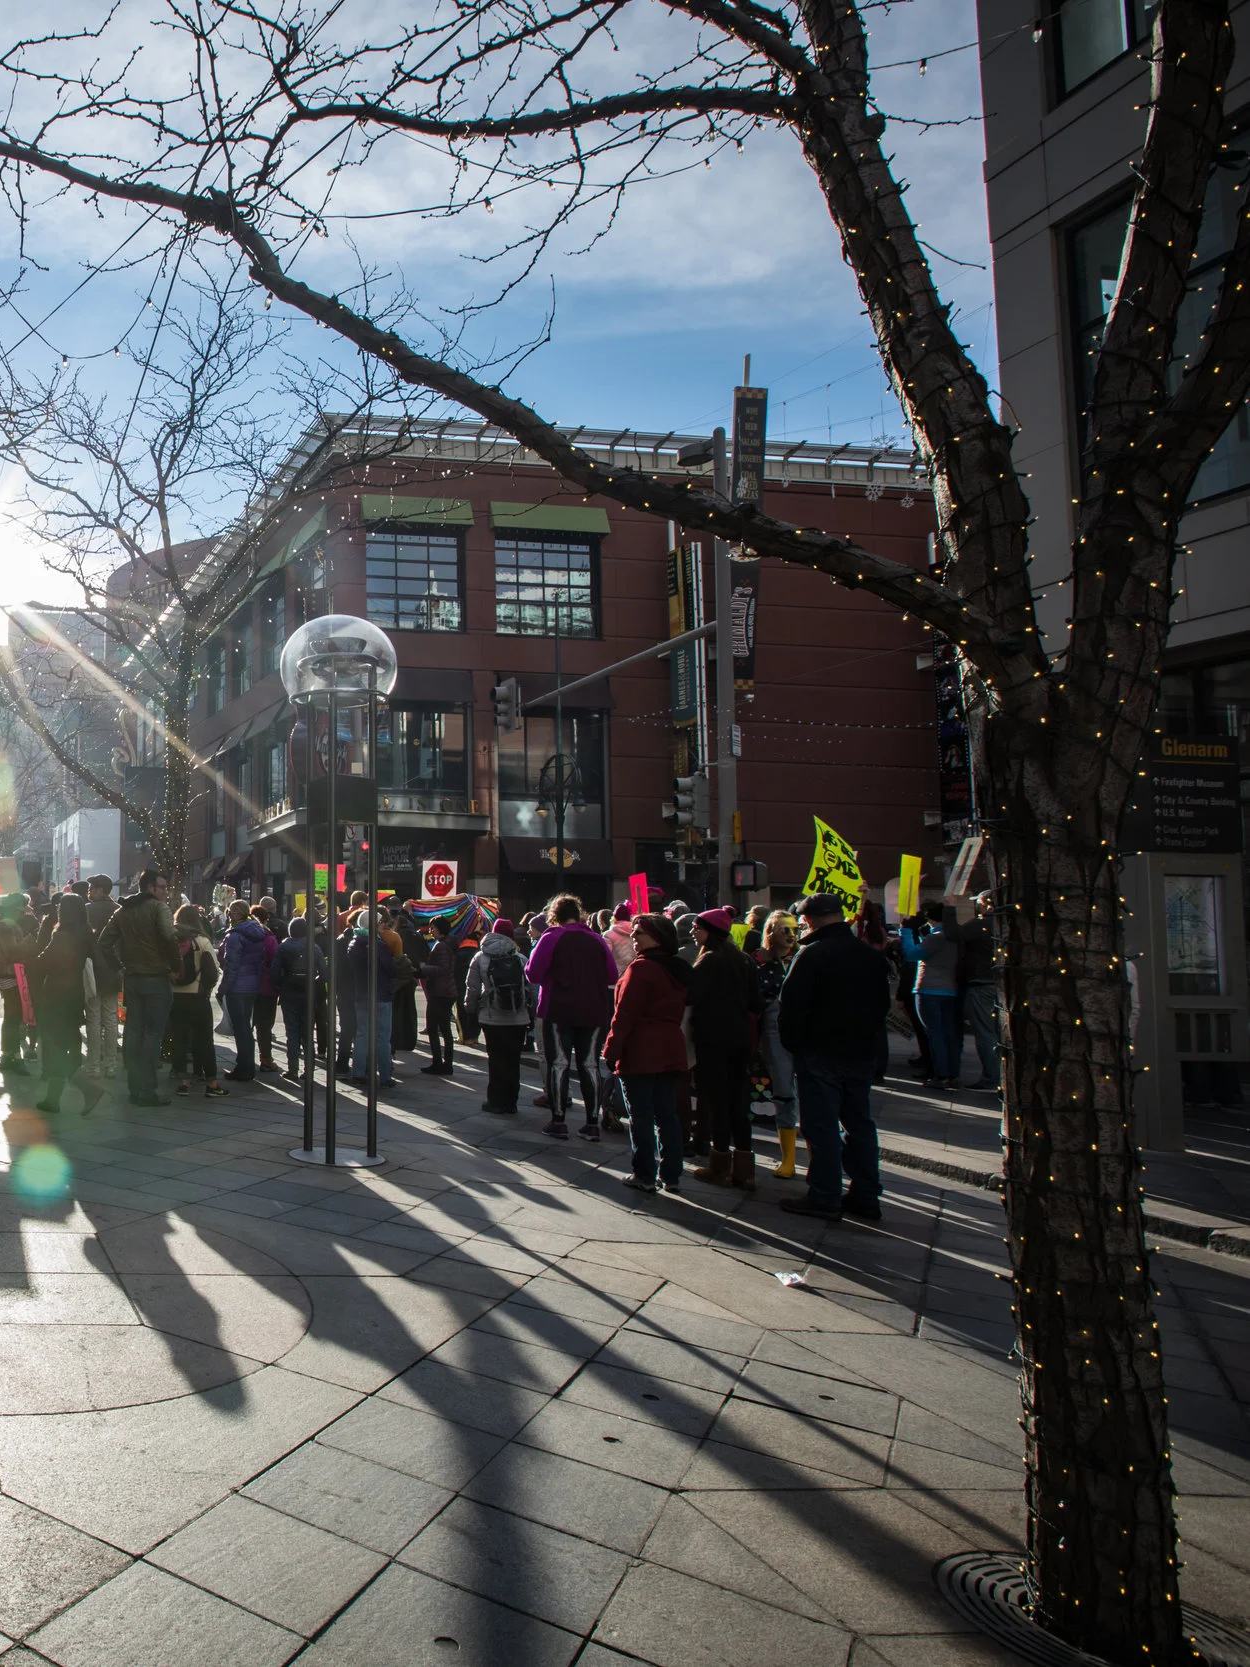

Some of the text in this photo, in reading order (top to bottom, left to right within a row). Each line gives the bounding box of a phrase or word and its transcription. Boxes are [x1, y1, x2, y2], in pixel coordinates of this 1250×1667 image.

[1161, 738, 1228, 757] Glenarm
[1160, 777, 1225, 788] Firefighter Museum
[1162, 796, 1237, 808] City & County Building
[1162, 808, 1195, 818] U.S. Mint
[1180, 826, 1203, 835] Center
[1204, 827, 1219, 836] Park
[382, 845, 408, 854] HAPPY
[383, 854, 410, 863] HOUR
[427, 874, 453, 885] STOP
